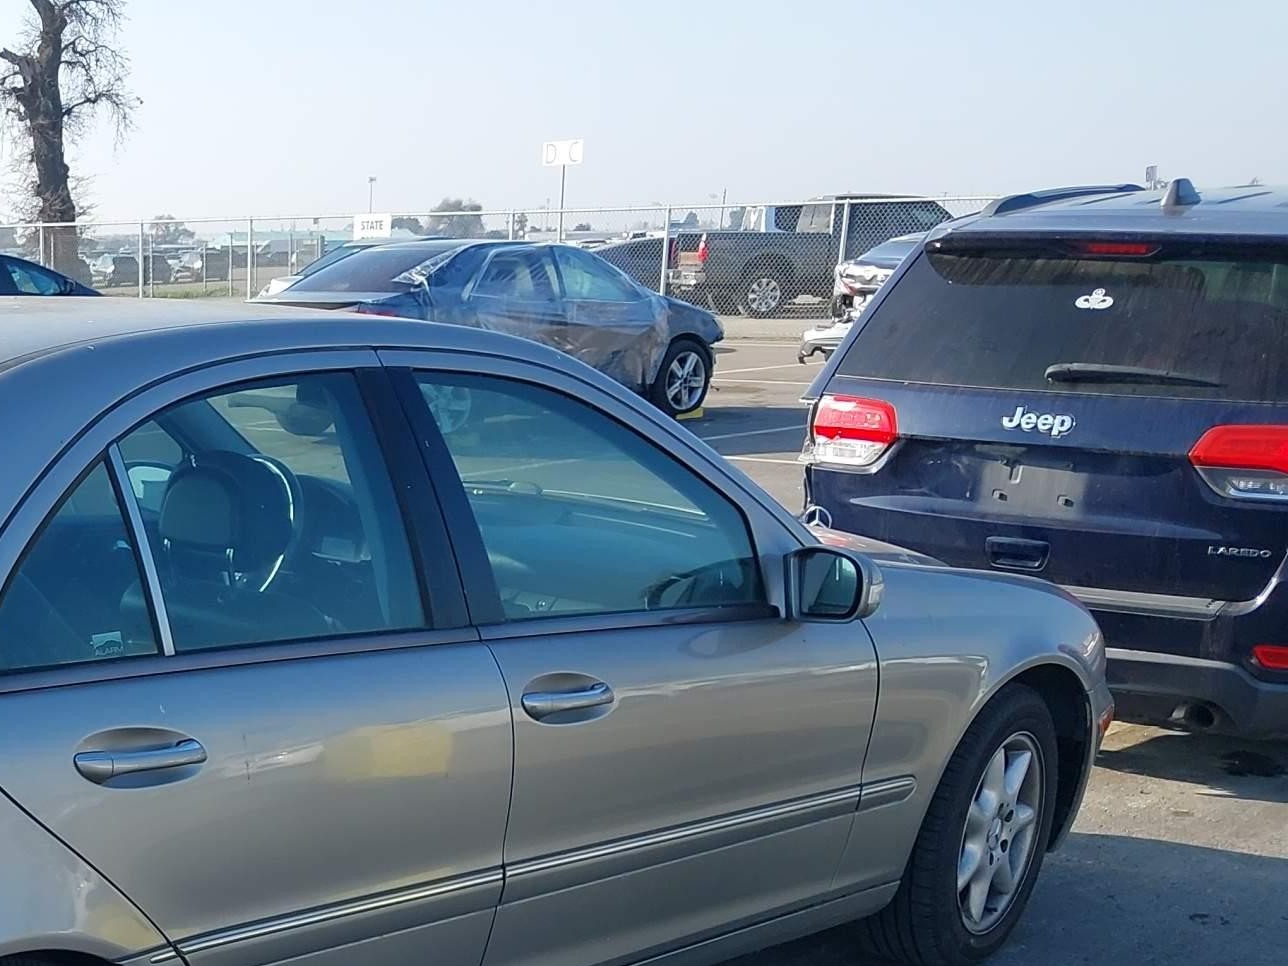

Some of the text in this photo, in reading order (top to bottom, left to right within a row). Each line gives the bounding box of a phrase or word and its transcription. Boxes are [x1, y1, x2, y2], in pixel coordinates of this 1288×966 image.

[546, 141, 579, 164] D C
[361, 220, 384, 231] STATE
[1001, 405, 1074, 438] Jeep
[1207, 546, 1272, 558] LAREDO
